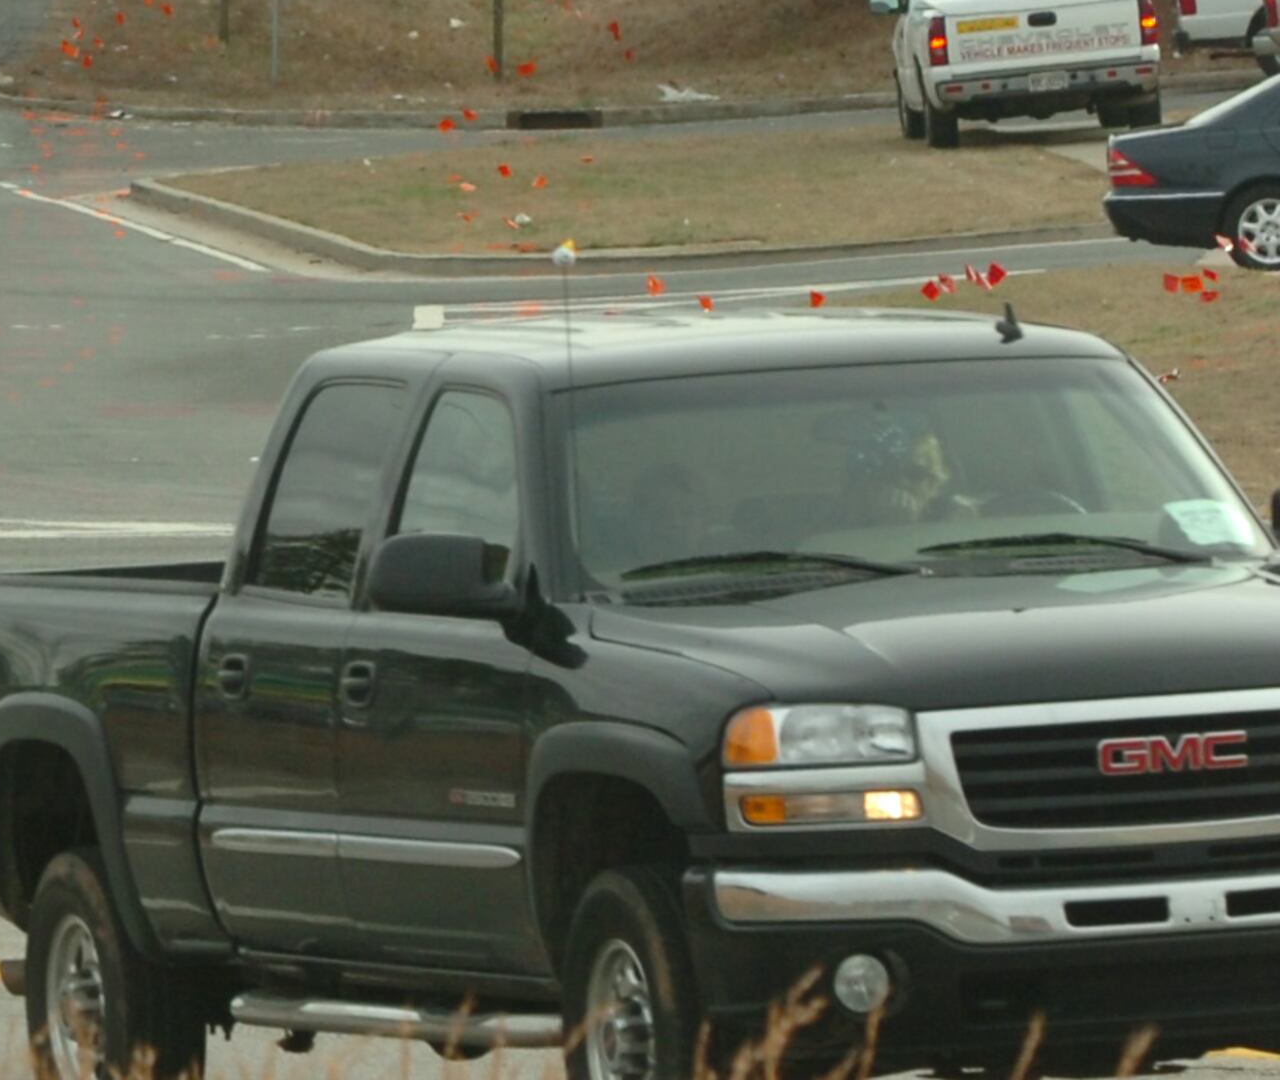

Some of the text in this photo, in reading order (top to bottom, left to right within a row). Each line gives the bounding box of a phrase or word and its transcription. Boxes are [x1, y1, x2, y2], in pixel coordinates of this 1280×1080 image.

[960, 47, 1003, 61] VEHICLE
[1006, 43, 1044, 56] MAKES
[1044, 38, 1096, 54] FREQUENT
[1097, 729, 1249, 776] GMC
